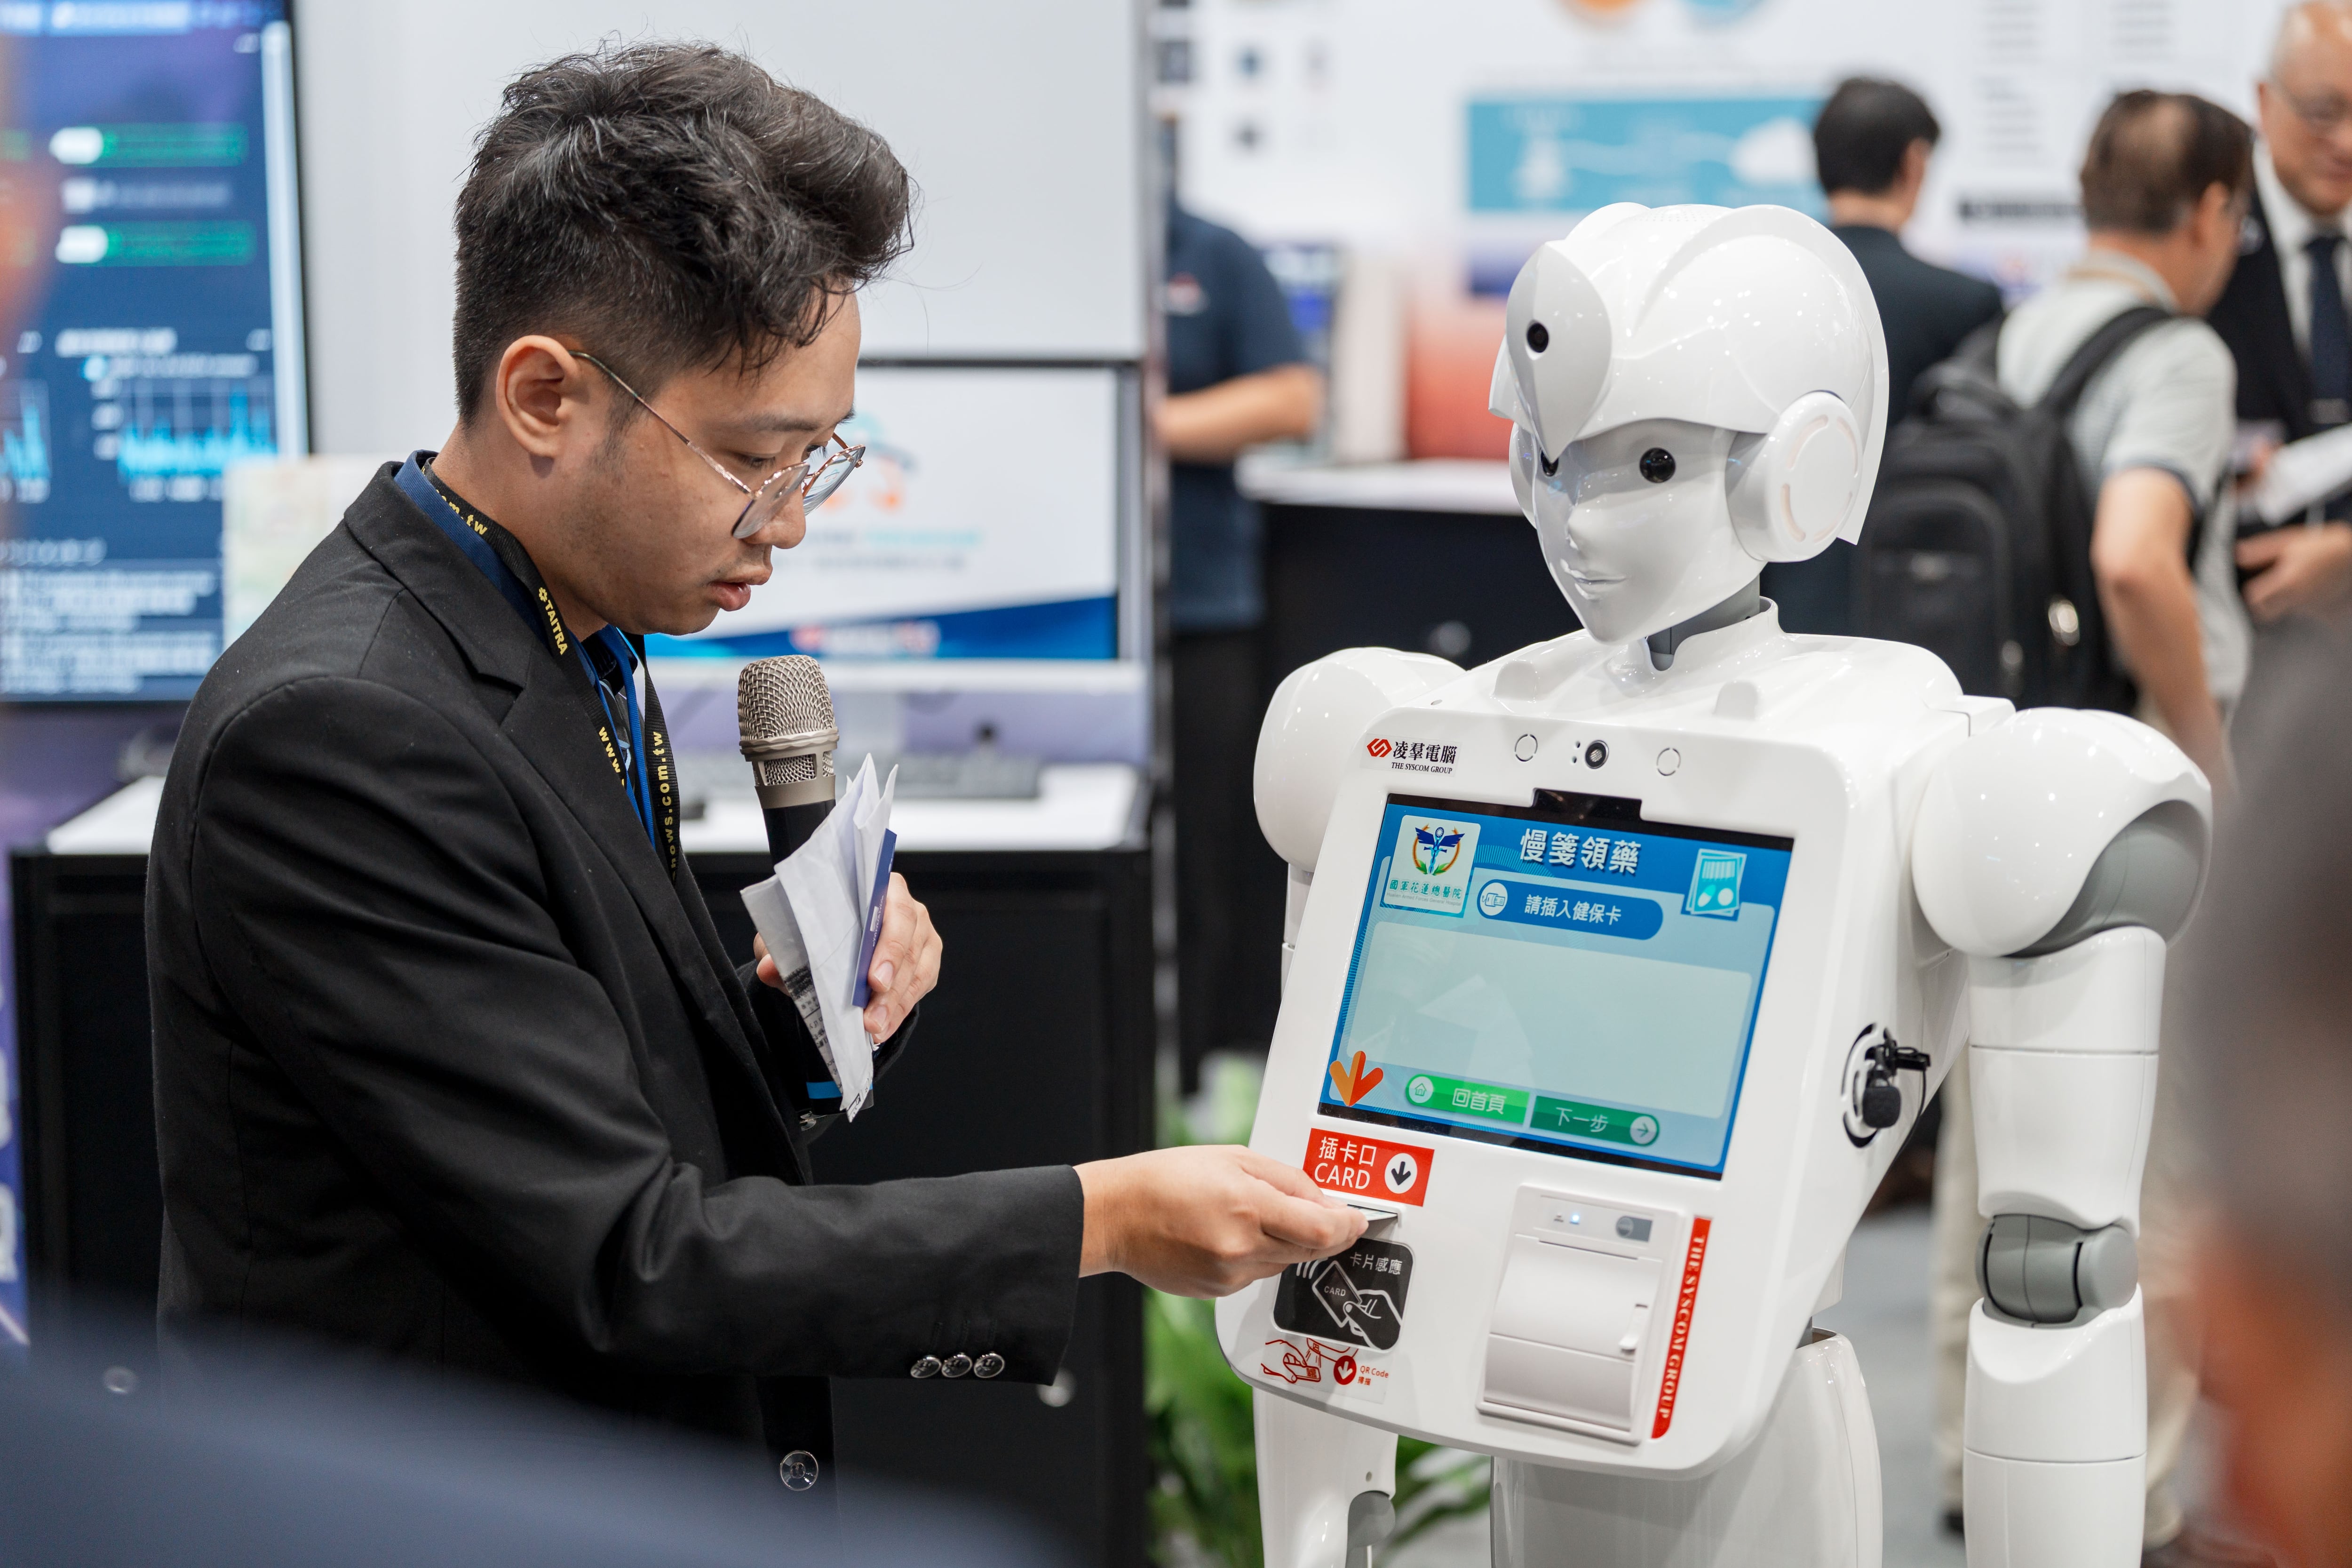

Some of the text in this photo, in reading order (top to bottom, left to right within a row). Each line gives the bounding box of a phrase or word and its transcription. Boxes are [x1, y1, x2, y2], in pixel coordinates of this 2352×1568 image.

[545, 599, 568, 655] TAITRA
[1405, 763, 1430, 772] SYSCOM
[1430, 765, 1453, 774] GROUP
[1519, 828, 1642, 875] 慢箋領藥
[1390, 879, 1462, 899] 國軍花蓮總醫院
[1525, 894, 1622, 926] 請插入健保卡
[1452, 1088, 1507, 1115] 回首頁
[1556, 1107, 1609, 1133] 下一步
[1318, 1136, 1377, 1167] 插卡口
[1314, 1162, 1371, 1190] CARD
[1350, 1251, 1403, 1275] 卡片感應
[1324, 1286, 1346, 1297] CARD
[1659, 1235, 1706, 1419] THE SYSCOM GROUP
[1360, 1365, 1389, 1378] QR Code
